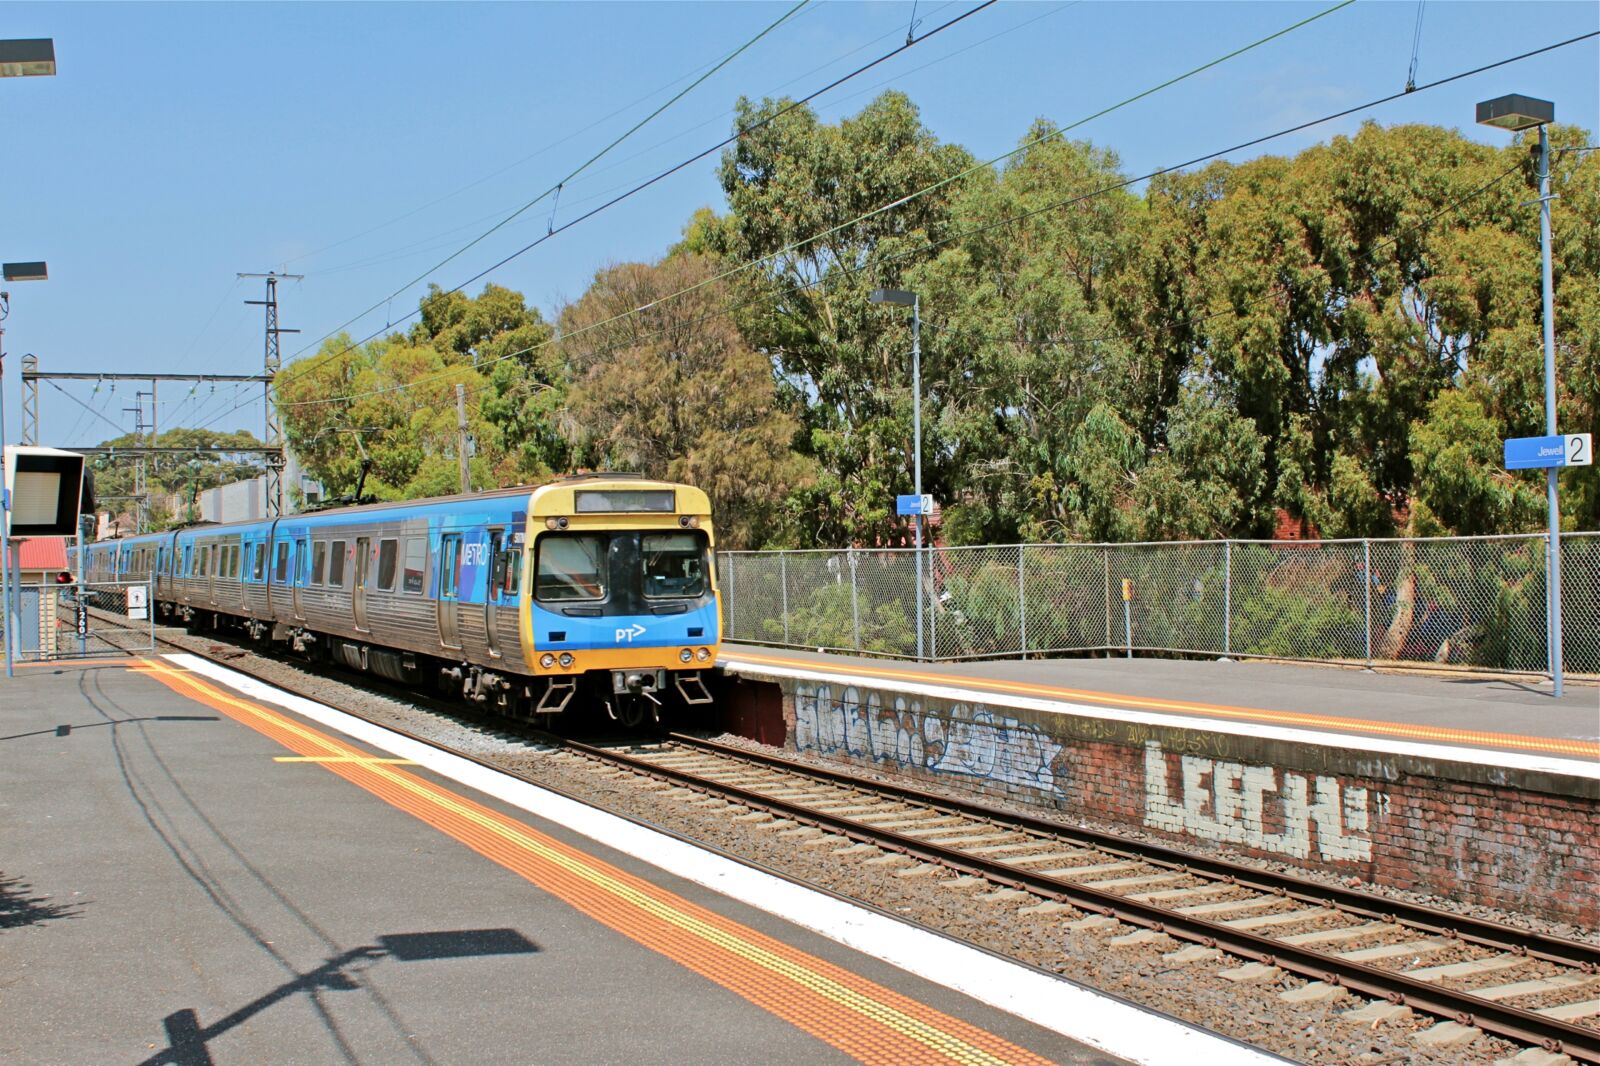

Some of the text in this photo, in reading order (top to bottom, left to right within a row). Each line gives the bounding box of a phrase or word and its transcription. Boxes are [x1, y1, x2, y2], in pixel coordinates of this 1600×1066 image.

[1537, 437, 1584, 463] Jewell 2
[922, 496, 929, 513] 2
[461, 543, 487, 566] METRO
